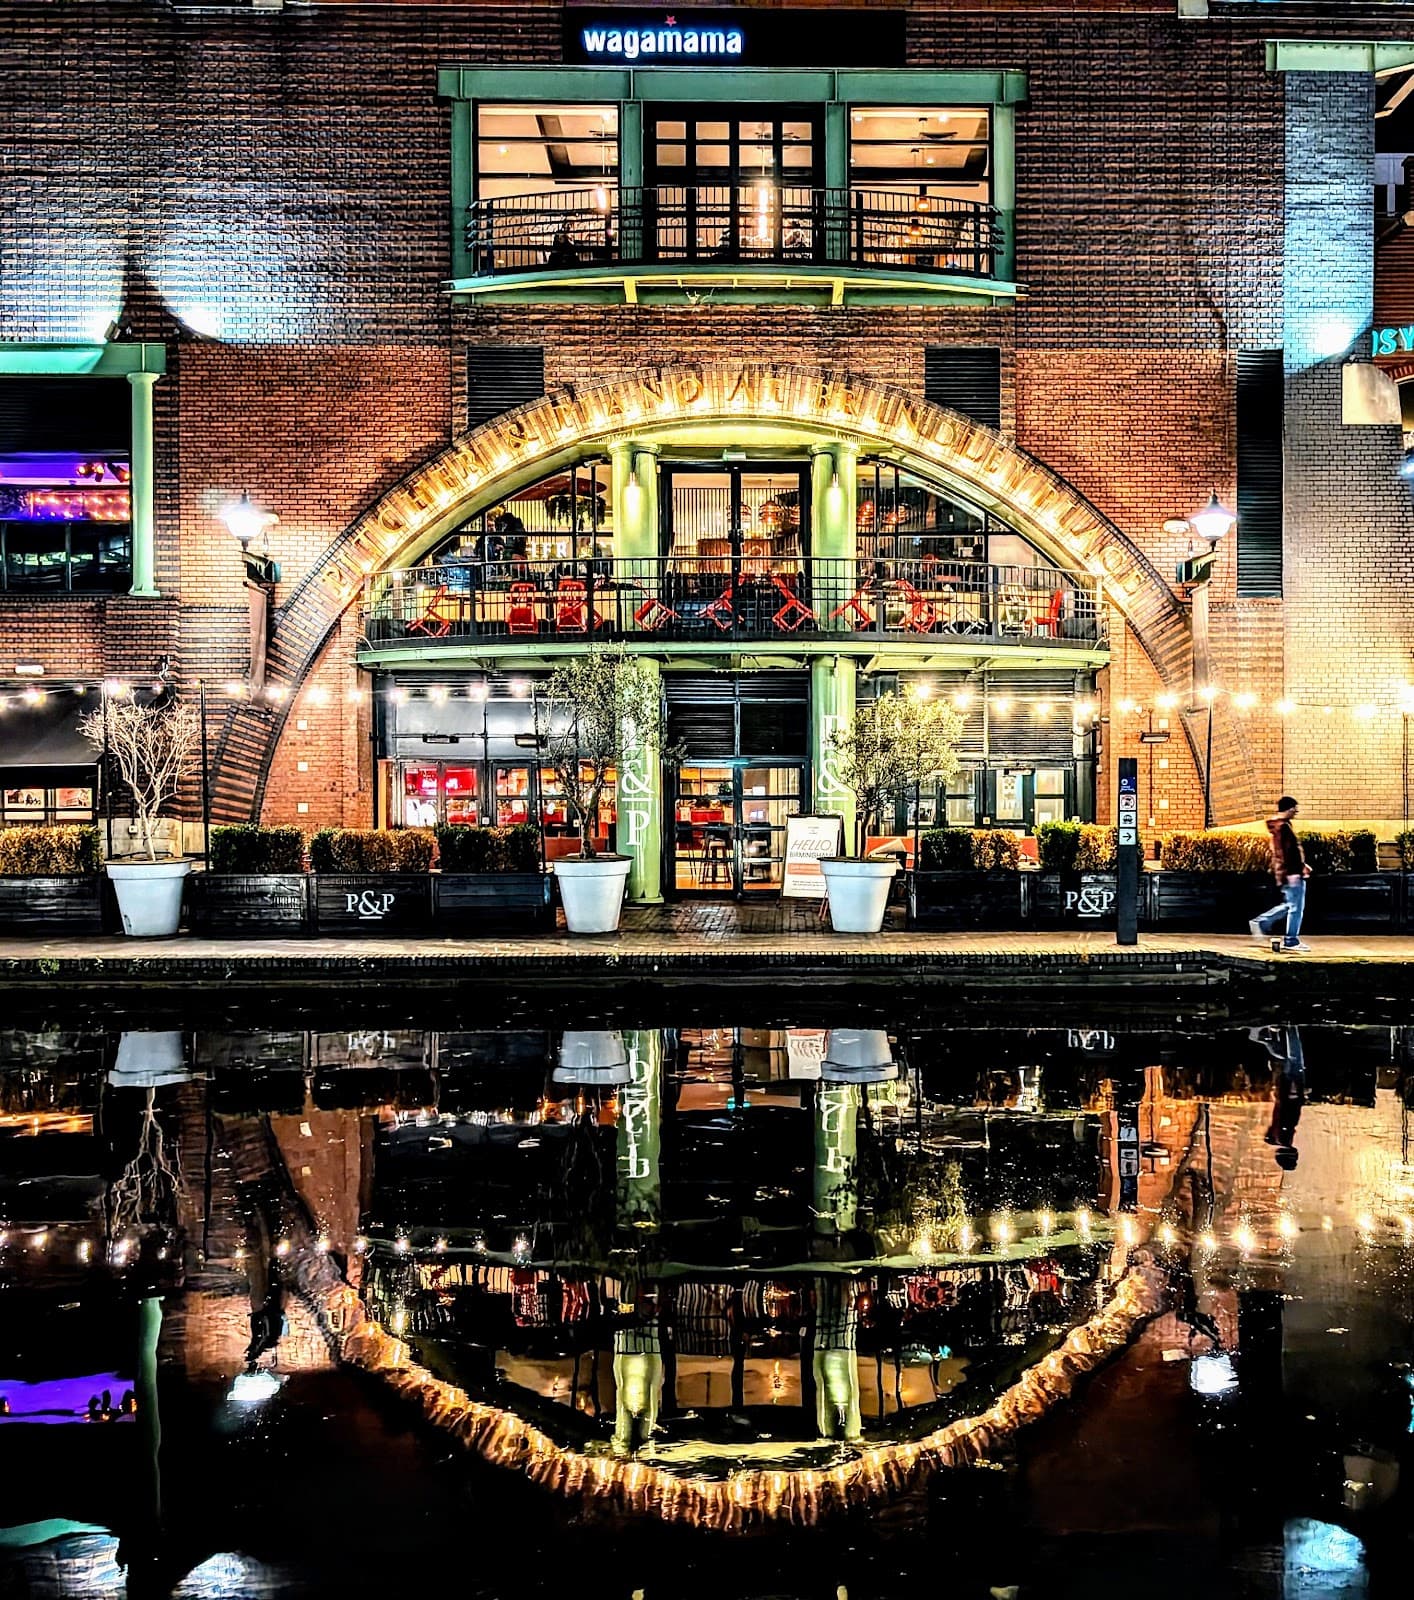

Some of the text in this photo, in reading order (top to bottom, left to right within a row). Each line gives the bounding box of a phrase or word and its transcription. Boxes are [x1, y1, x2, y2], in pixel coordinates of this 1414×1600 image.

[583, 30, 742, 59] wagamama
[322, 450, 490, 596] PITCHER
[507, 423, 540, 449] &
[551, 377, 704, 430] PIANO
[728, 371, 785, 404] AT
[790, 839, 834, 852] HELLO,
[345, 890, 395, 919] P&P
[1065, 888, 1115, 917] P&P
